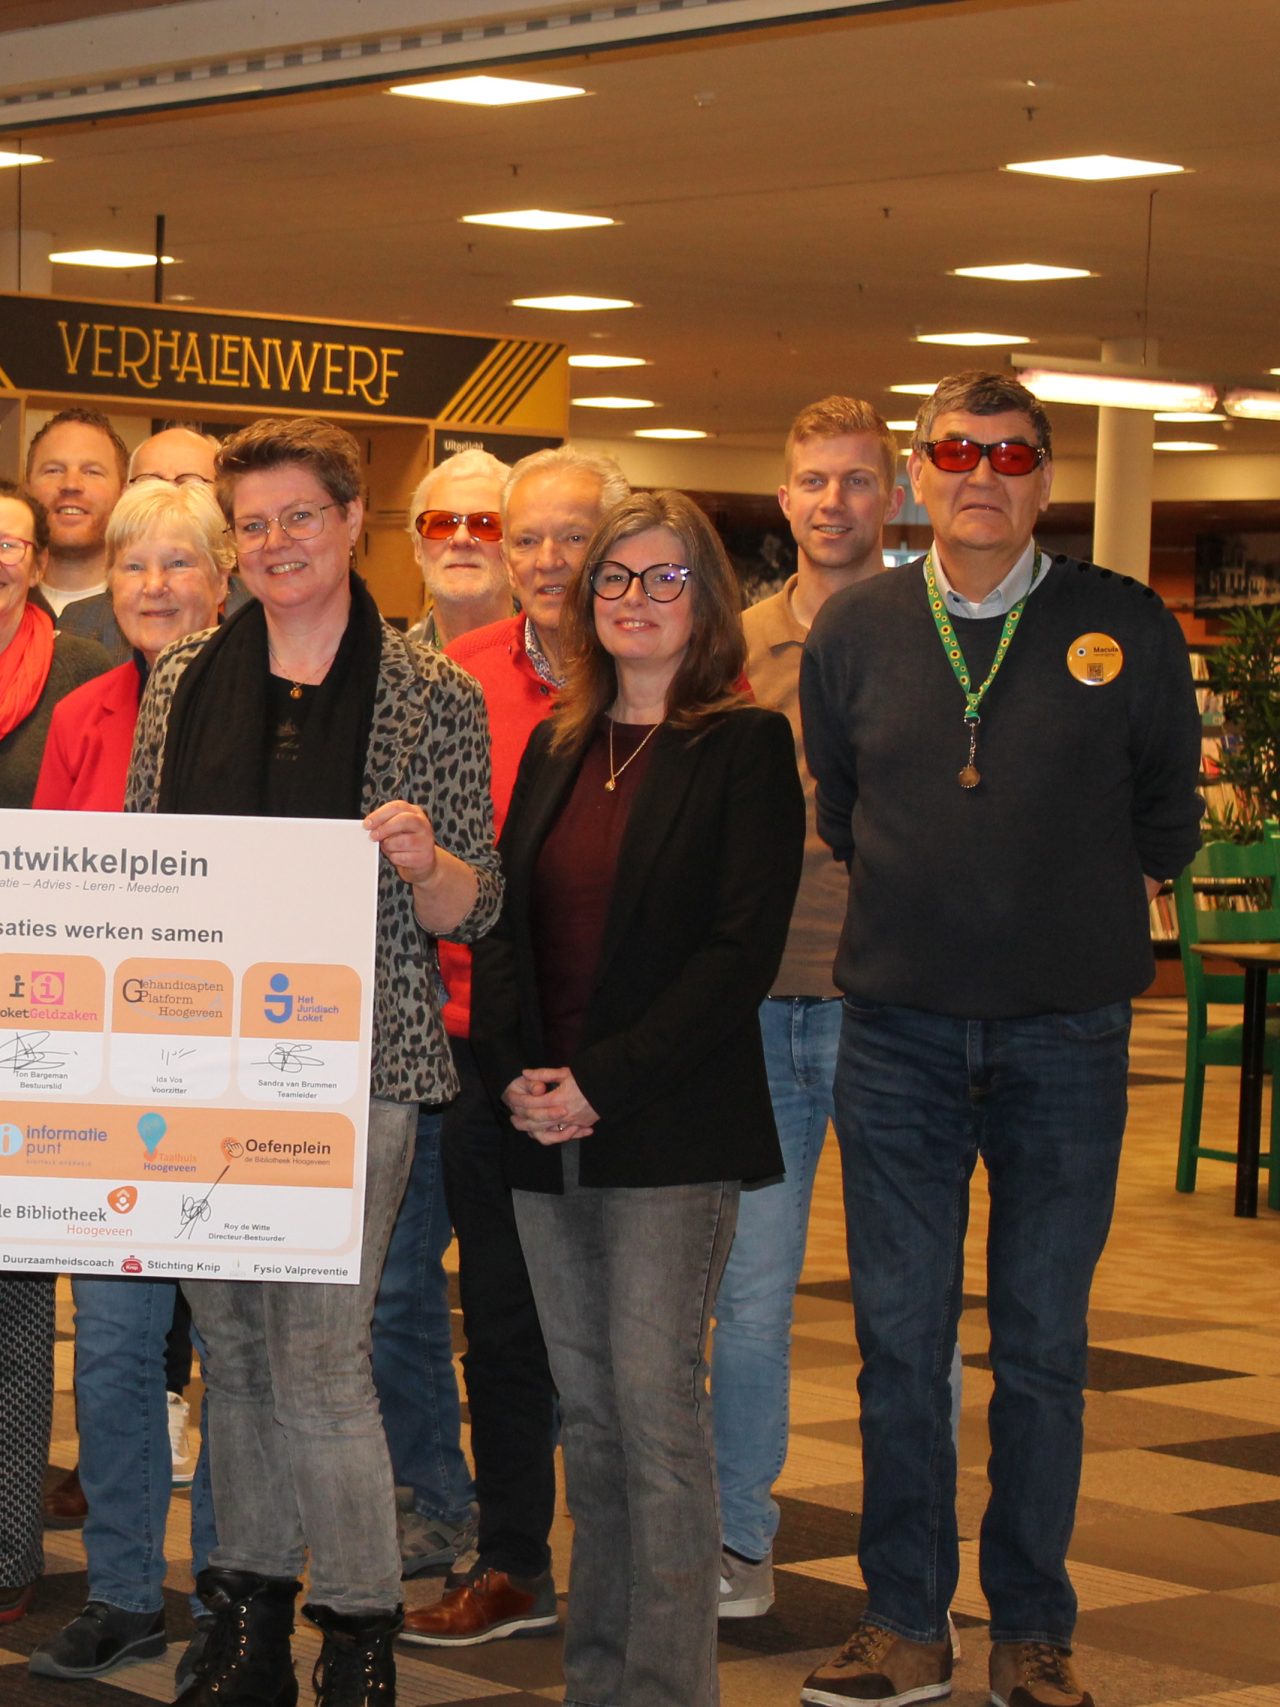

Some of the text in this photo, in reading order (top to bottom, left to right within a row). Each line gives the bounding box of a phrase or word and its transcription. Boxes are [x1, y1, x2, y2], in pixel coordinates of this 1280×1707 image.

[57, 321, 404, 406] VERHALENWERF
[33, 877, 72, 890] Advies
[83, 880, 115, 892] Leren
[126, 881, 180, 894] Meedoen
[65, 922, 144, 940] werken
[151, 925, 224, 943] samen
[122, 978, 224, 1003] Gehandicapten
[140, 990, 193, 1004] Platform
[297, 995, 314, 1004] Het
[159, 1006, 223, 1019] Hoogeveen
[297, 1005, 339, 1014] Juridisch
[297, 1014, 323, 1022] Loket
[30, 1071, 68, 1080] Bargeman
[20, 1082, 62, 1090] Bestuurslid
[258, 1079, 284, 1088] Sandra
[301, 1081, 337, 1089] Brummen
[151, 1086, 187, 1095] Voorzitter
[277, 1091, 317, 1099] Teamleider
[26, 1125, 108, 1142] informatie
[26, 1142, 61, 1157] punt
[245, 1138, 331, 1157] Oefenplein
[255, 1156, 290, 1165] Bibliotheek
[292, 1157, 330, 1166] Hoogeveen
[143, 1162, 197, 1173] Hoogeveen
[17, 1205, 107, 1222] Bibliotheek
[67, 1224, 133, 1237] Hoogeveen
[224, 1223, 239, 1231] Roy
[252, 1223, 270, 1231] Witte
[208, 1233, 285, 1242] Directeur-Bestuurder
[3, 1255, 114, 1267] Duurzaamheidscoach
[147, 1260, 221, 1273] Stichting Knip
[254, 1265, 281, 1275] Fysio
[285, 1265, 348, 1277] Valpreventie
